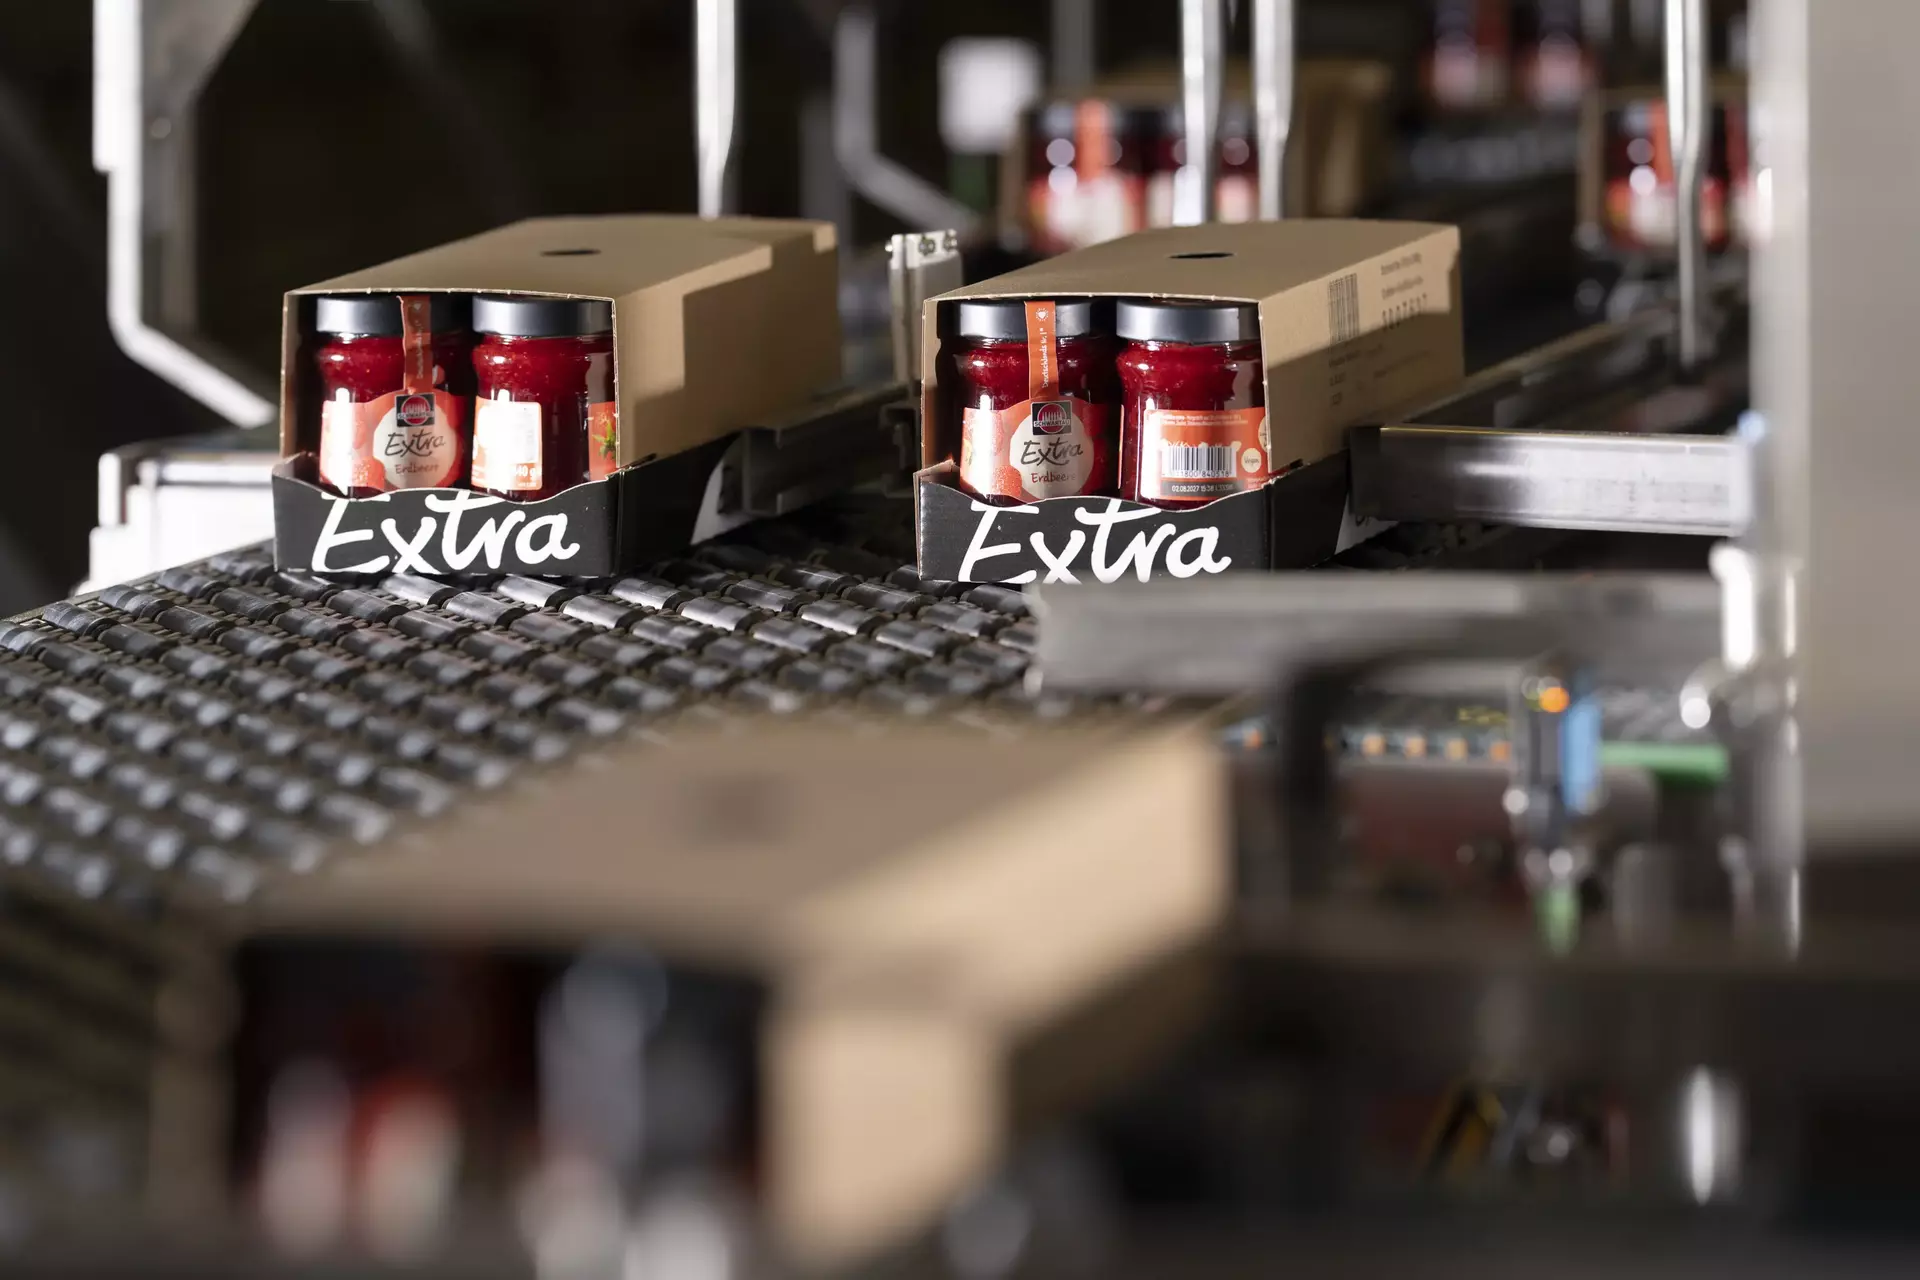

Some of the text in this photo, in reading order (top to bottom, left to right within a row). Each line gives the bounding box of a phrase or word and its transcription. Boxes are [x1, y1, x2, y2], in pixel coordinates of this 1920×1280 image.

[1033, 419, 1071, 428] SCHWARTAU
[384, 428, 446, 457] Extra
[1020, 437, 1084, 466] Extra
[311, 490, 580, 575] Extra
[959, 500, 1232, 585] Extra
